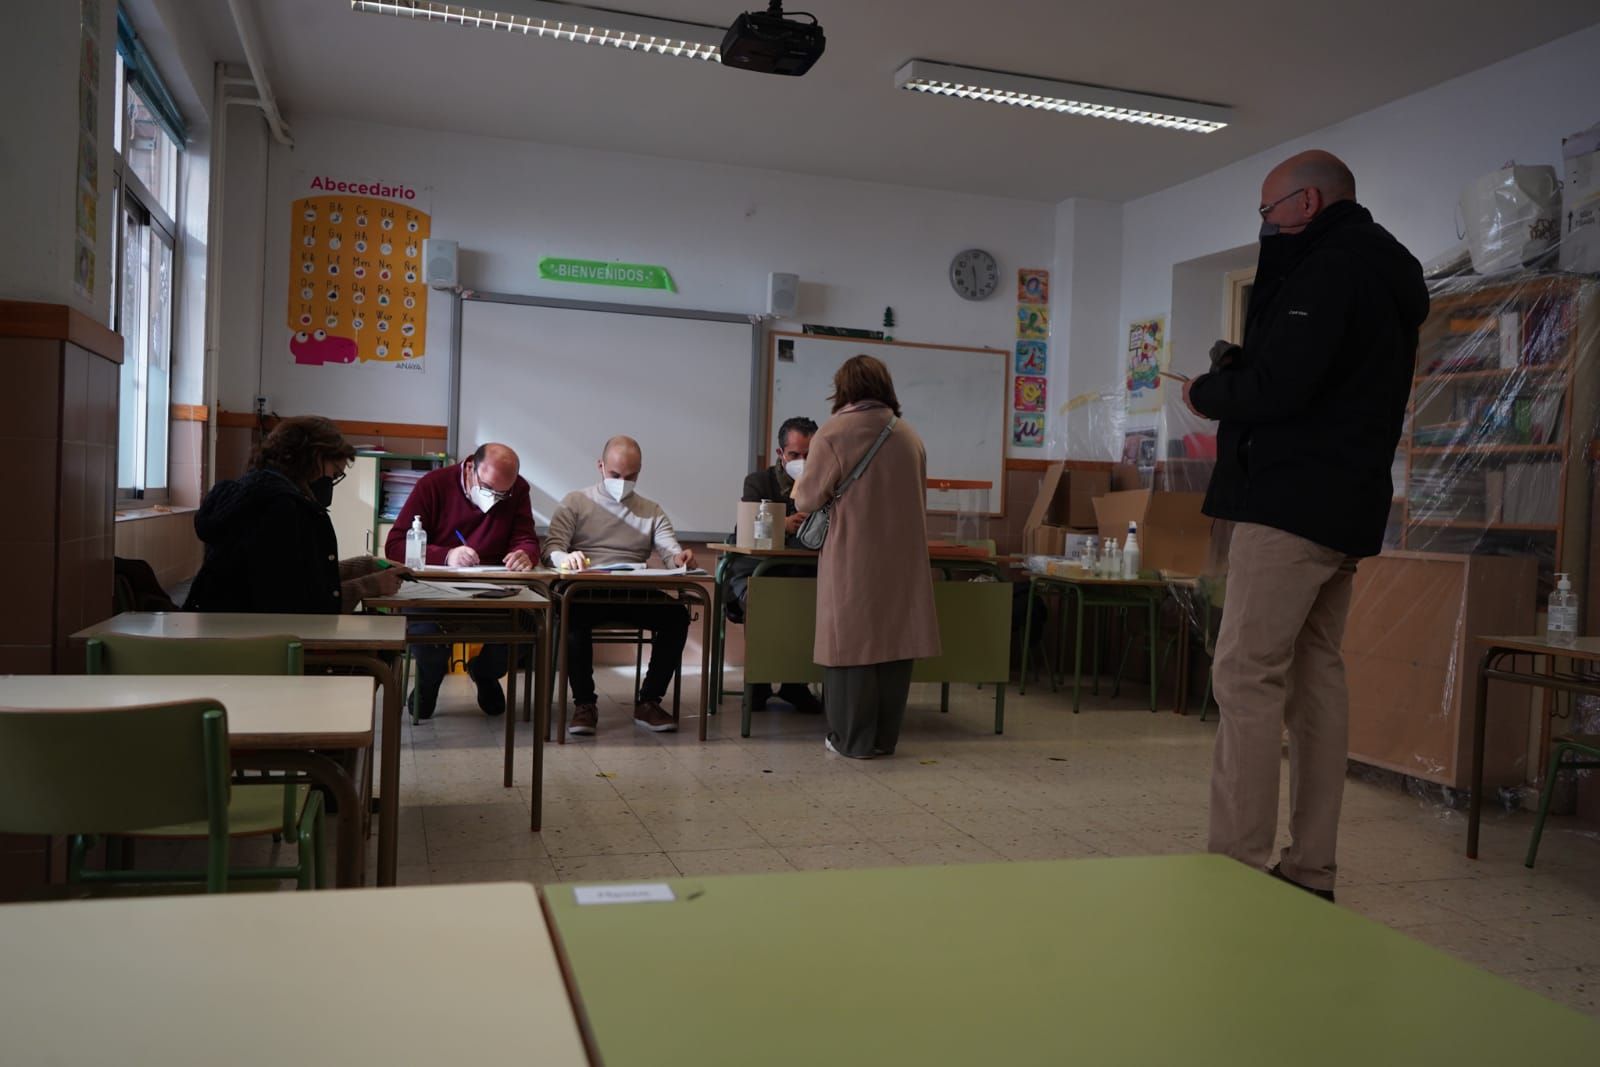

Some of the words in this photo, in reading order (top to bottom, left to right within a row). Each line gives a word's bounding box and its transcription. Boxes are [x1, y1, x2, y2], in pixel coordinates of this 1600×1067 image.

[311, 176, 416, 200] Abecedario
[559, 264, 644, 282] BIENVENIDOS
[396, 362, 422, 370] ANAYA
